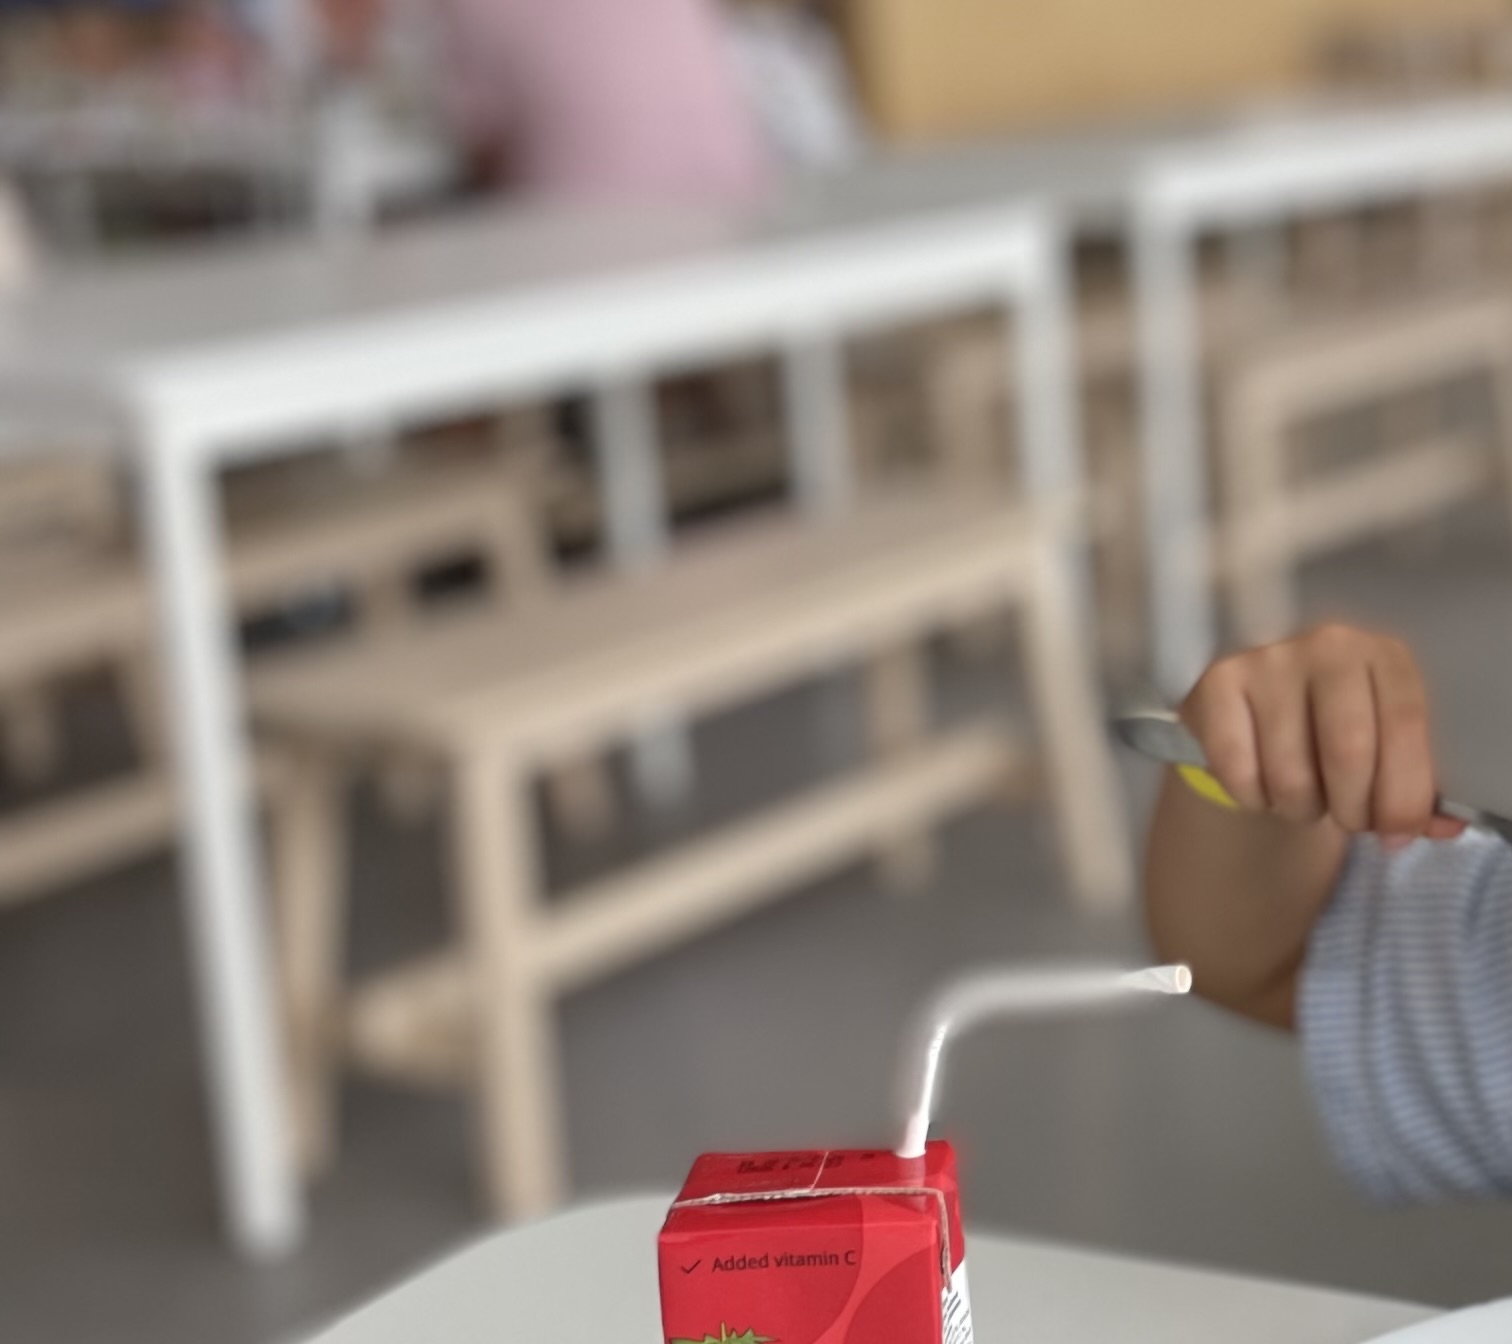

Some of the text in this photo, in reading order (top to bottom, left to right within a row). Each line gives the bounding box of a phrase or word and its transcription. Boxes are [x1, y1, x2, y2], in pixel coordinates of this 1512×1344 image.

[712, 1249, 856, 1272] Added vitamin C
